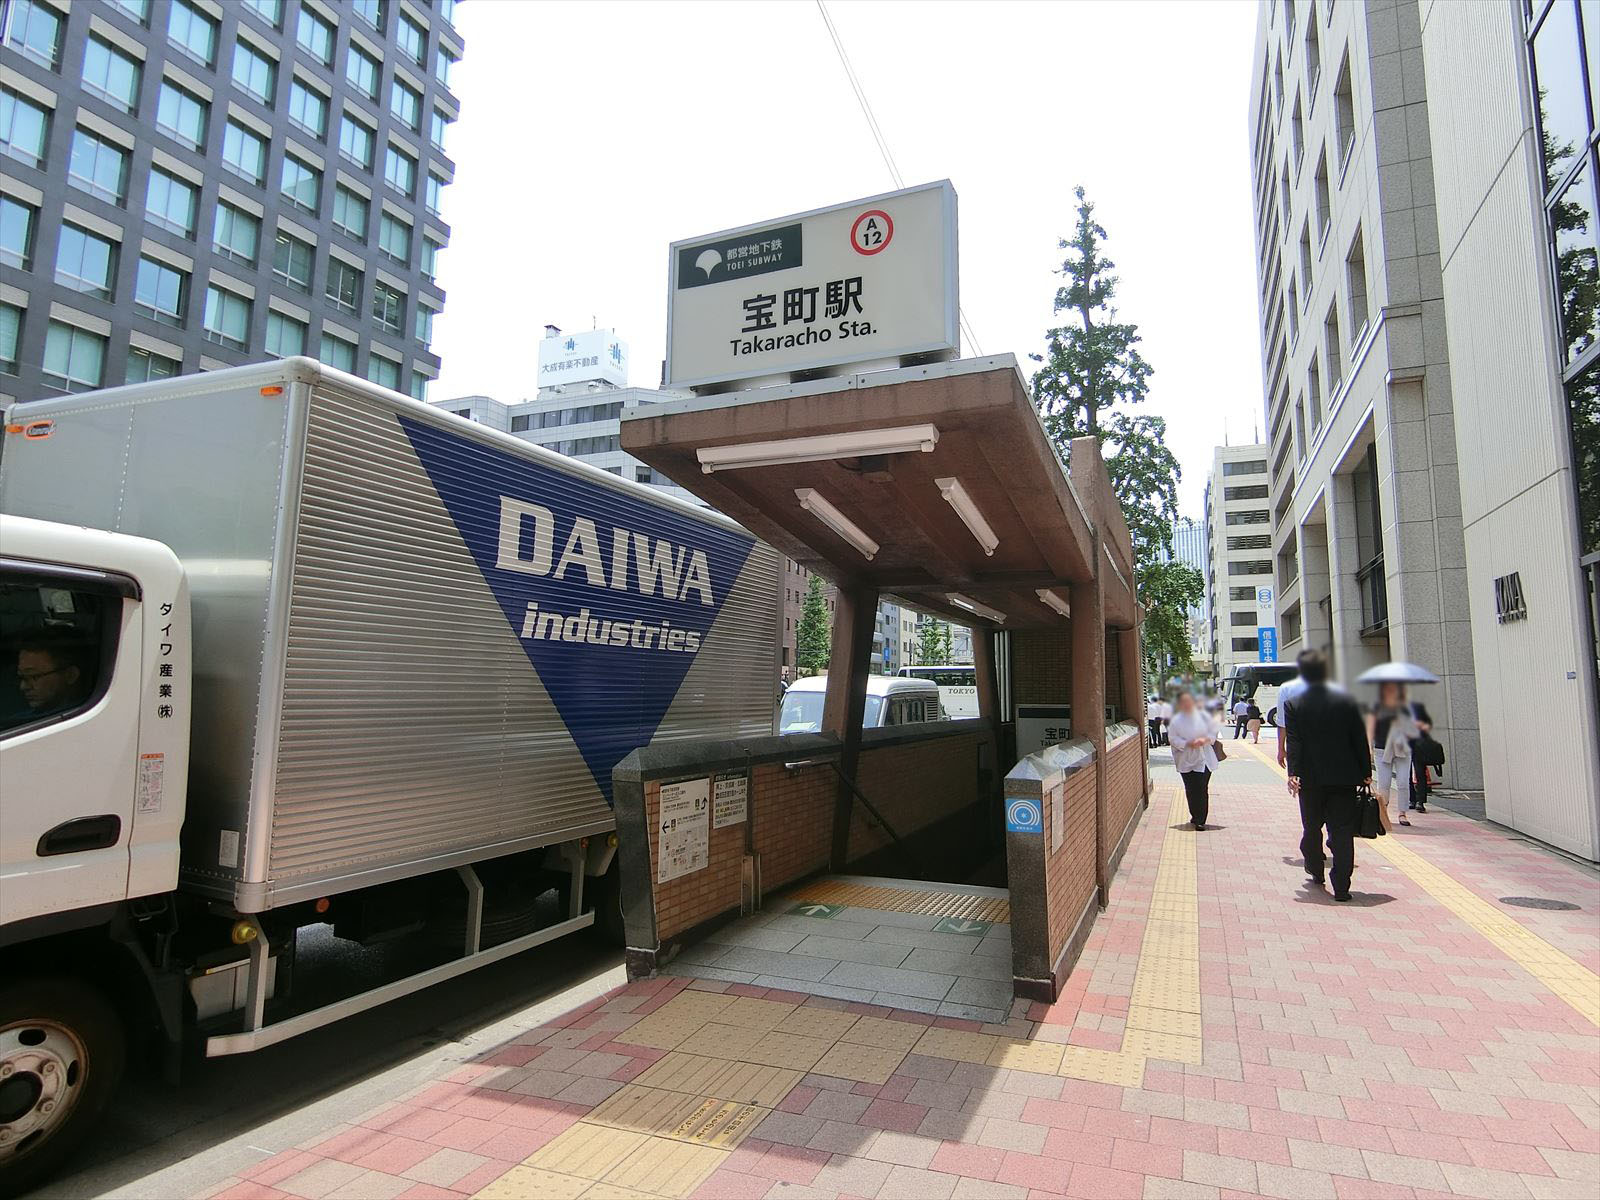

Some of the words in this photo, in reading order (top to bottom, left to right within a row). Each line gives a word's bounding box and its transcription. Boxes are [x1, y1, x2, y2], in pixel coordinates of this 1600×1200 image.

[864, 231, 882, 246] 12
[866, 218, 877, 231] A
[726, 238, 782, 260] 都営地下鉄
[727, 262, 745, 271] TOEI
[748, 253, 782, 267] SUBWAY
[742, 276, 863, 333] 宝町駅
[730, 327, 831, 356] Takaracho
[839, 321, 877, 339] Sta.
[495, 495, 715, 606] DAIWA
[521, 601, 701, 653] industries
